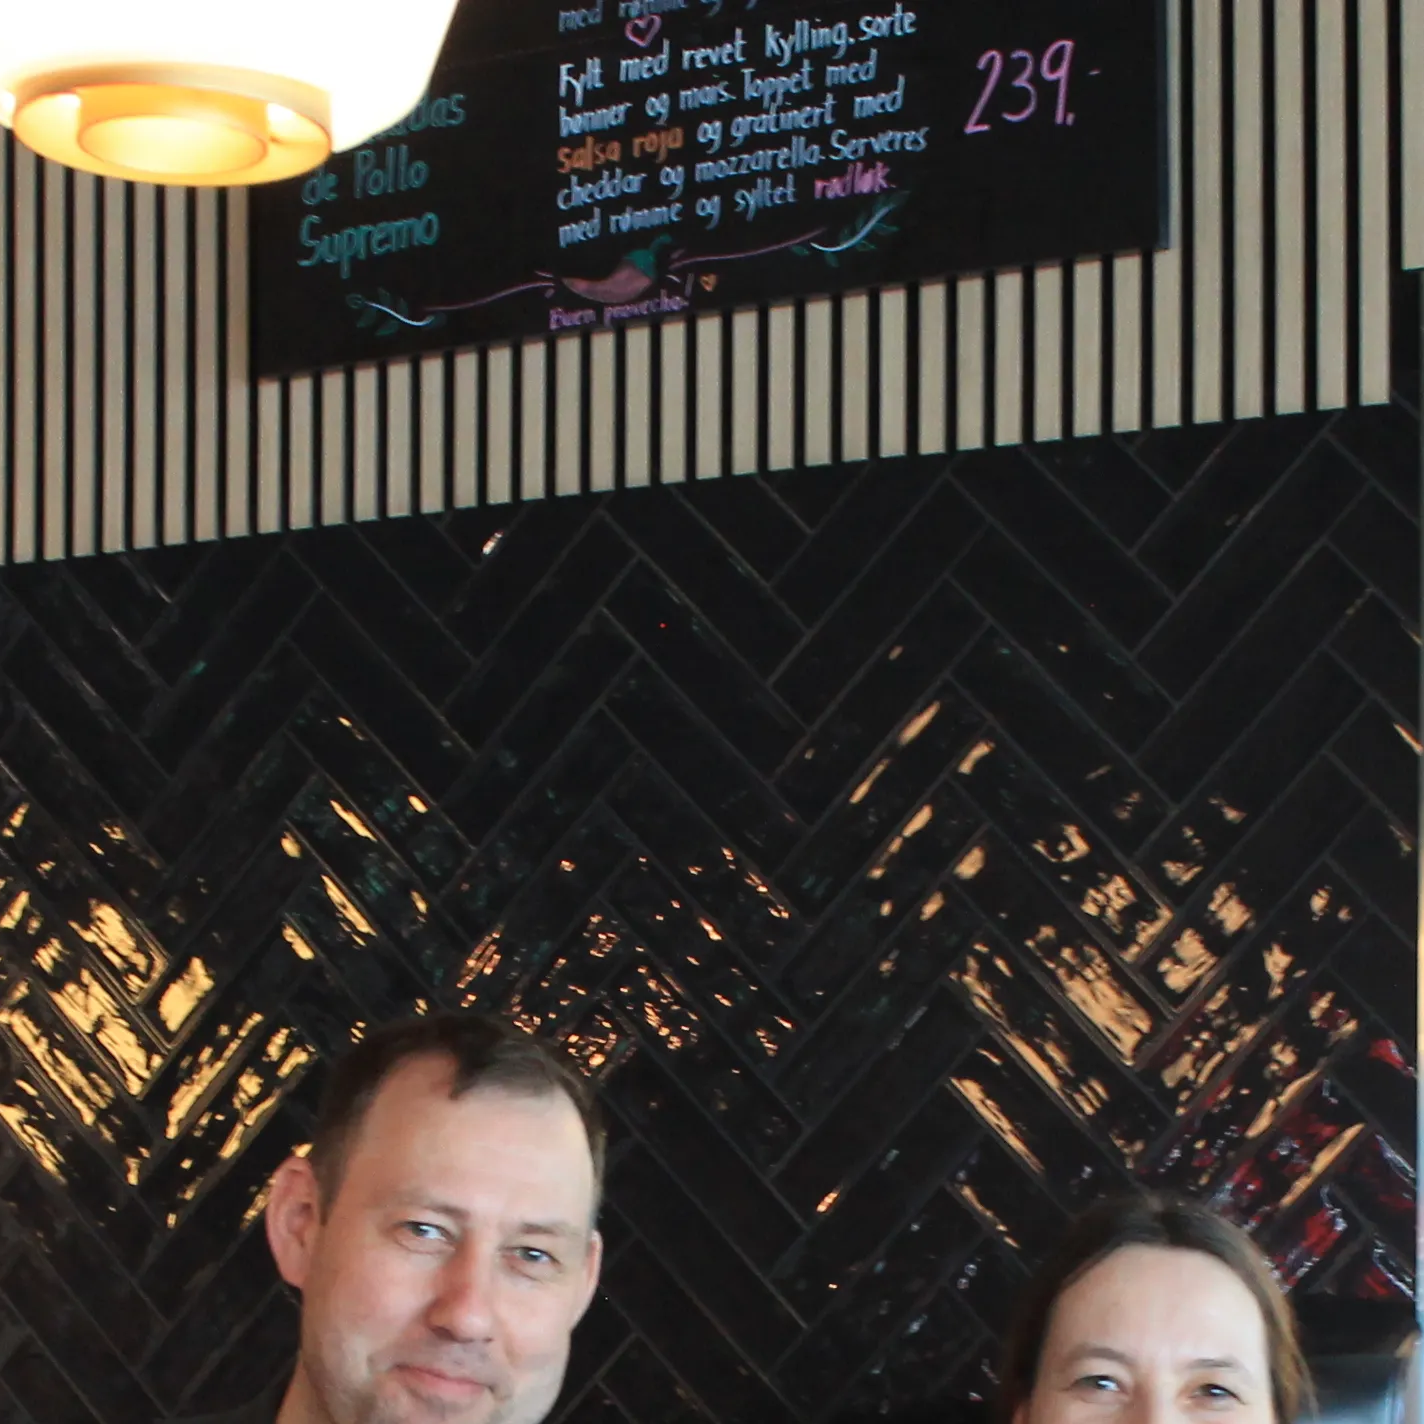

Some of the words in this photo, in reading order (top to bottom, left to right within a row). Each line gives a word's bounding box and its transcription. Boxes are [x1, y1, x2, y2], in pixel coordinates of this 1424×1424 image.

[558, 56, 604, 108] Fylt
[619, 38, 670, 82] med
[681, 27, 747, 71] revet
[644, 92, 670, 126] og
[825, 47, 878, 88] med
[696, 120, 723, 154] og
[730, 92, 838, 147] gratinert
[853, 74, 906, 120] med
[301, 164, 339, 206] de
[353, 144, 430, 199] Pollo
[556, 166, 648, 210] cheddar
[659, 164, 685, 200] og
[557, 206, 600, 248] med
[695, 193, 721, 229] og
[734, 173, 797, 222] syltet
[296, 211, 440, 279] Supremo
